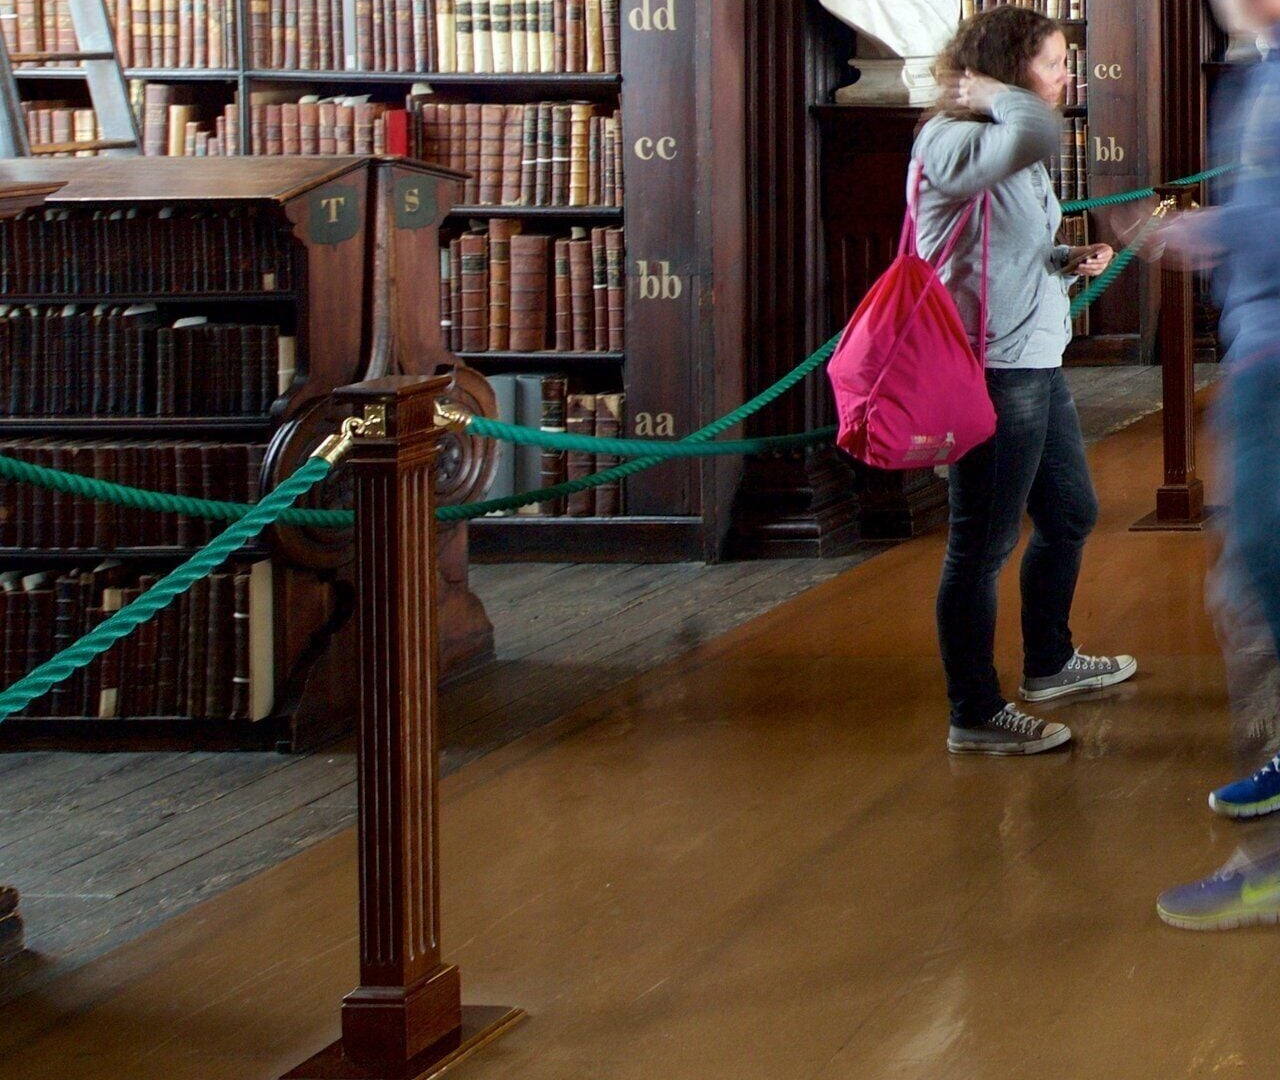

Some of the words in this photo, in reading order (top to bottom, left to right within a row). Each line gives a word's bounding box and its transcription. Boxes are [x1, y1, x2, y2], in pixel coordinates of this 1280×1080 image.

[1094, 64, 1122, 79] cc
[634, 136, 677, 161] cc
[1094, 136, 1124, 161] bb
[321, 197, 345, 222] T
[405, 188, 419, 212] S
[636, 260, 682, 299] bb
[635, 412, 674, 436] aa
